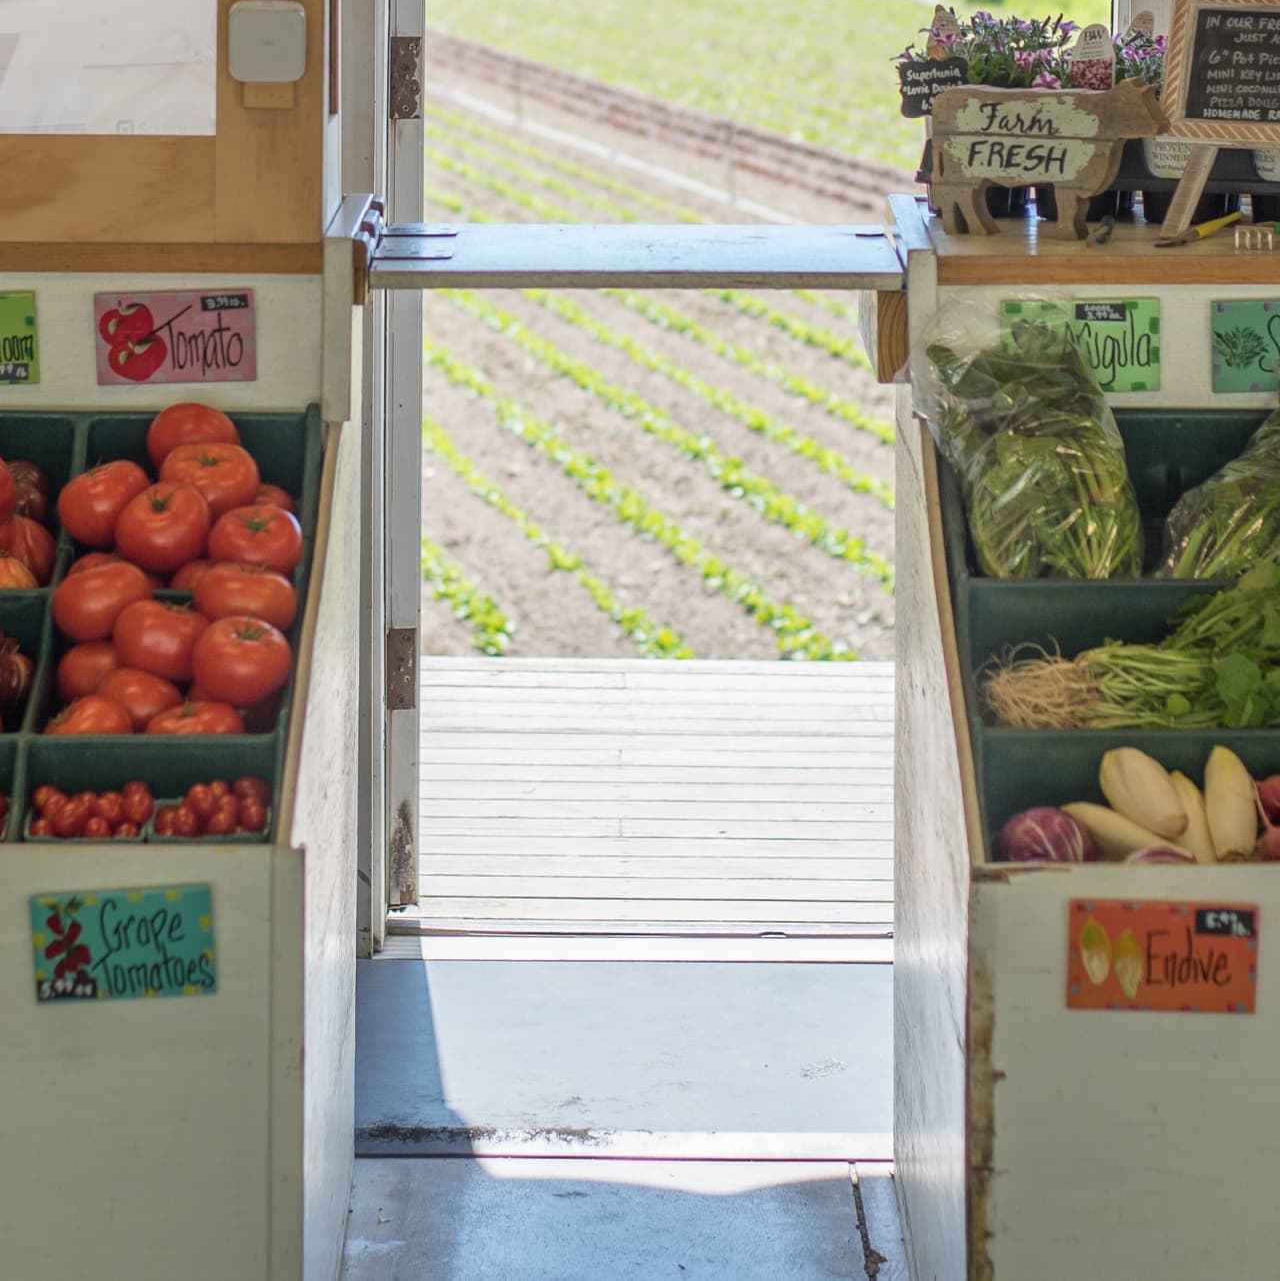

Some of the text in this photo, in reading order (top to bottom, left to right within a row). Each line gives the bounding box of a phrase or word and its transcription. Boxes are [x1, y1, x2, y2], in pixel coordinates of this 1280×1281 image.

[1205, 15, 1222, 30] IN
[1226, 17, 1254, 30] OUR
[1234, 33, 1268, 44] JUST
[1232, 51, 1255, 65] Pot
[1207, 69, 1235, 81] MINI
[1240, 70, 1263, 83] KEY
[1206, 84, 1233, 94] MINI
[1209, 96, 1245, 108] PIZZA
[979, 102, 1061, 136] Farm
[1203, 108, 1261, 120] HOMEMADE
[968, 140, 1068, 175] FRESH
[148, 304, 244, 376] Tomato
[99, 898, 185, 953] Grape
[1145, 926, 1232, 989] Endive
[91, 942, 215, 999] Tomatoes
